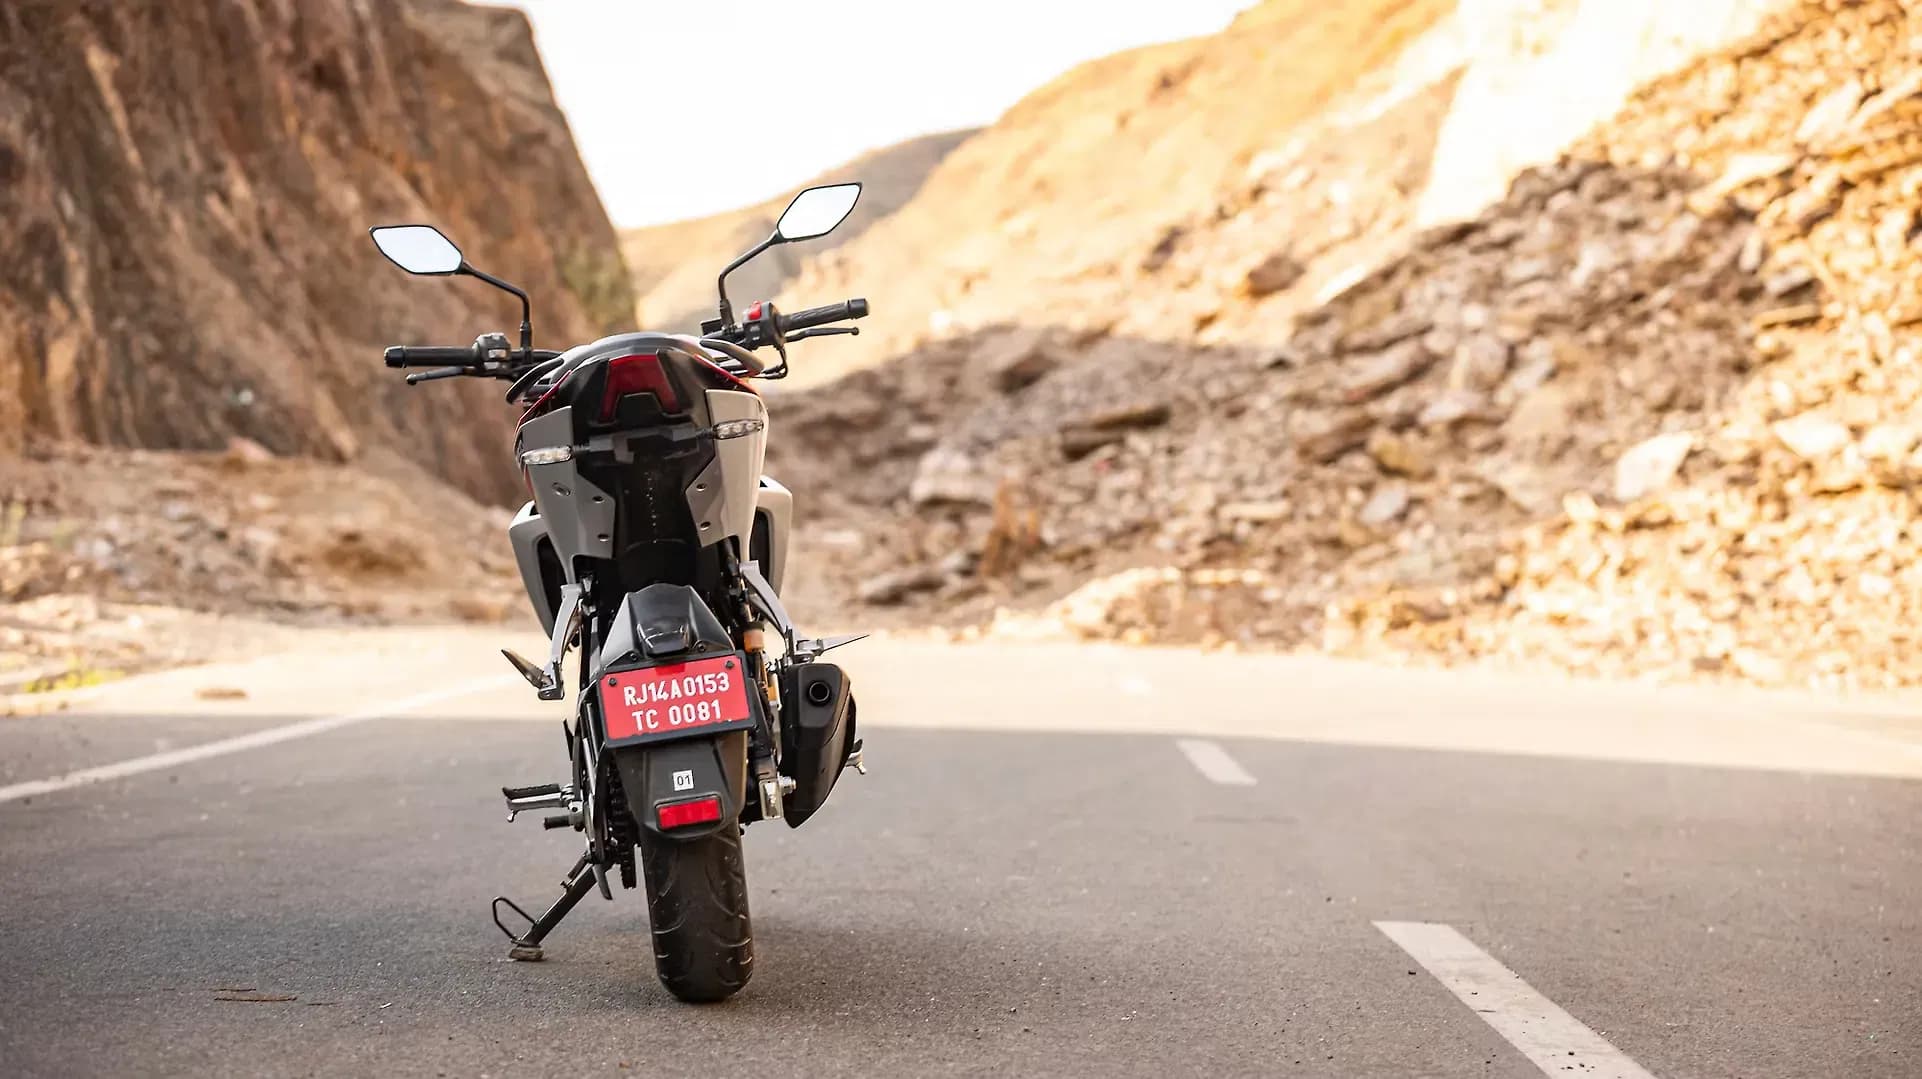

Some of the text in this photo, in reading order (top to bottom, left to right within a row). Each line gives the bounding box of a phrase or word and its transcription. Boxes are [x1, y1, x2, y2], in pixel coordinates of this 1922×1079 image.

[623, 671, 730, 706] RJ14A0153
[631, 699, 721, 731] TC 0081
[676, 775, 692, 786] 01
